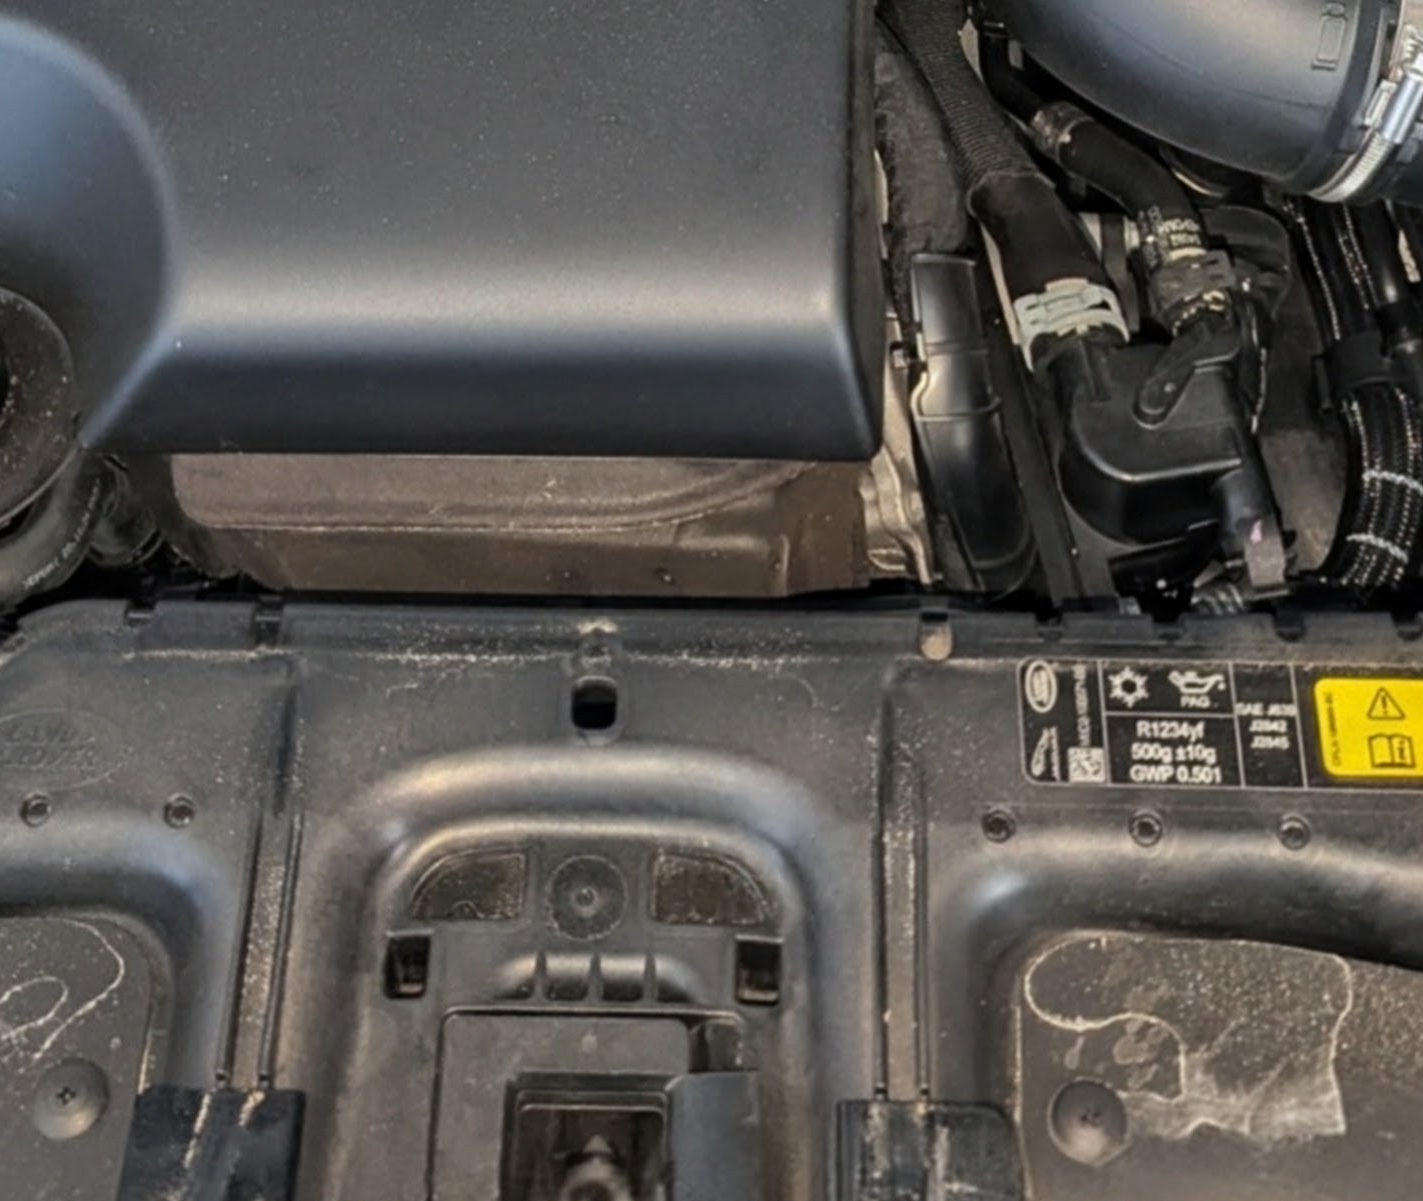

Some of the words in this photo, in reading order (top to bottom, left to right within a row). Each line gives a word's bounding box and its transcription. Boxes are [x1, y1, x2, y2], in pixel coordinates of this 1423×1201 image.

[1136, 720, 1205, 742] R1234yf
[1131, 742, 1173, 764] 500g
[1176, 743, 1217, 765] ±10g
[1129, 764, 1175, 782] GWP
[1176, 765, 1222, 784] 0.501
